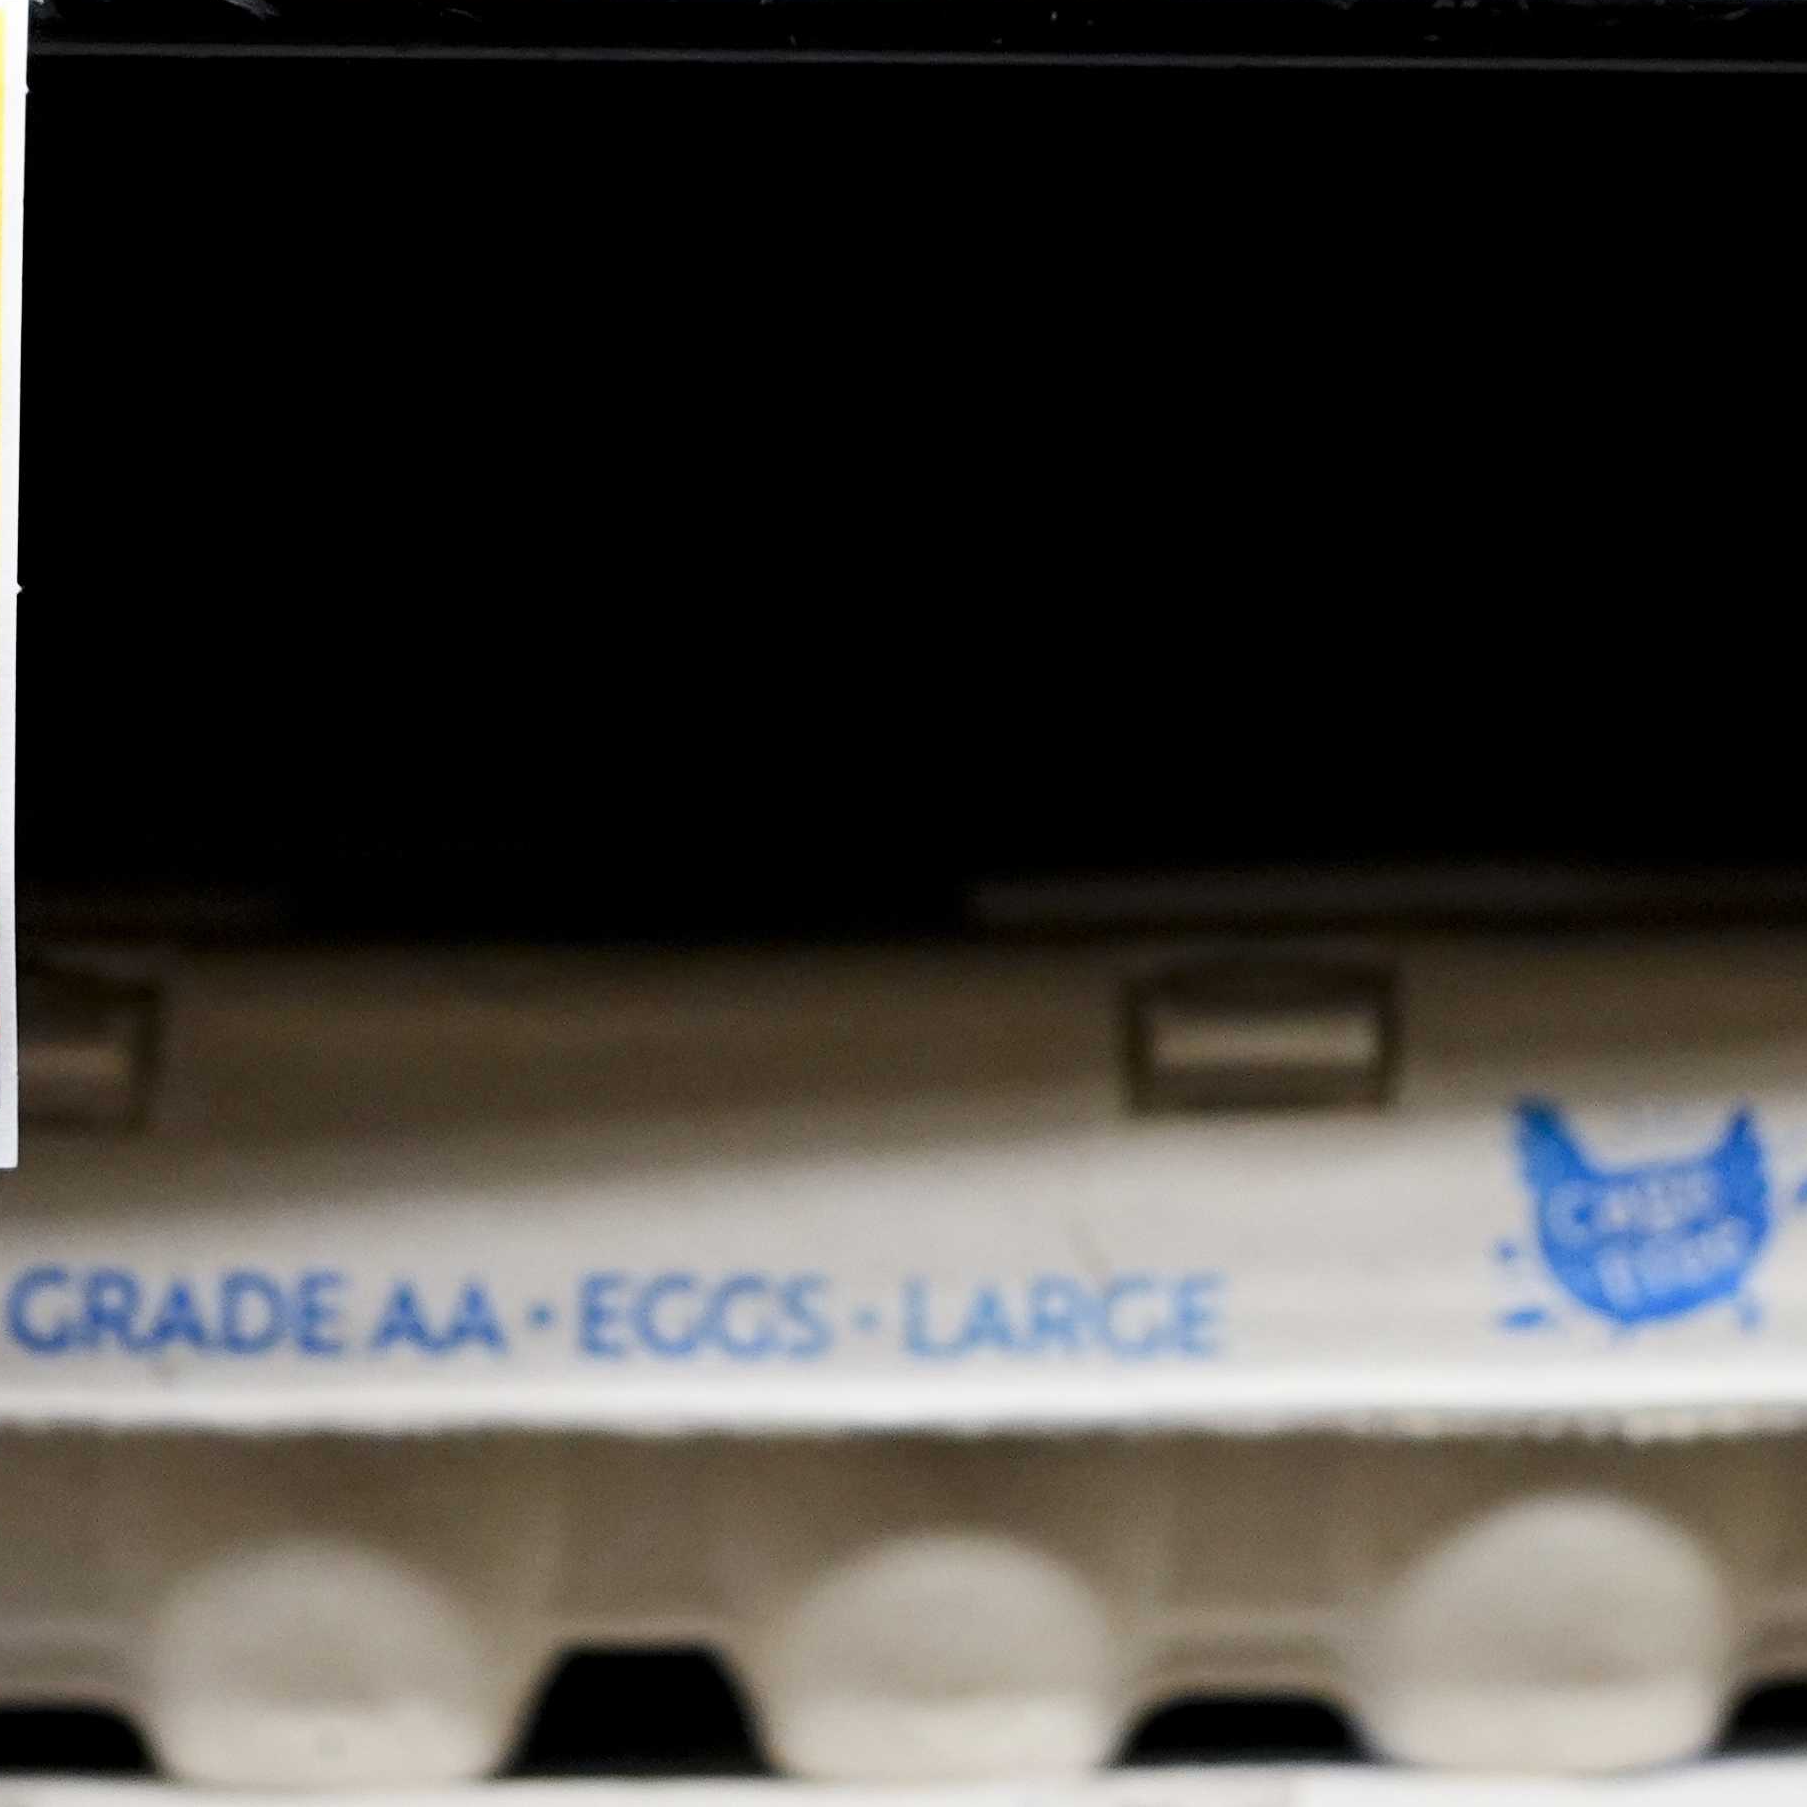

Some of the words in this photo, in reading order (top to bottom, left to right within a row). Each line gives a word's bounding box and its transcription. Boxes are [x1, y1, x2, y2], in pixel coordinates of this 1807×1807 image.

[2, 1262, 346, 1358] GRADE
[366, 1274, 511, 1357] AA
[577, 1272, 837, 1360] EGGS
[900, 1272, 1228, 1360] LARGE
